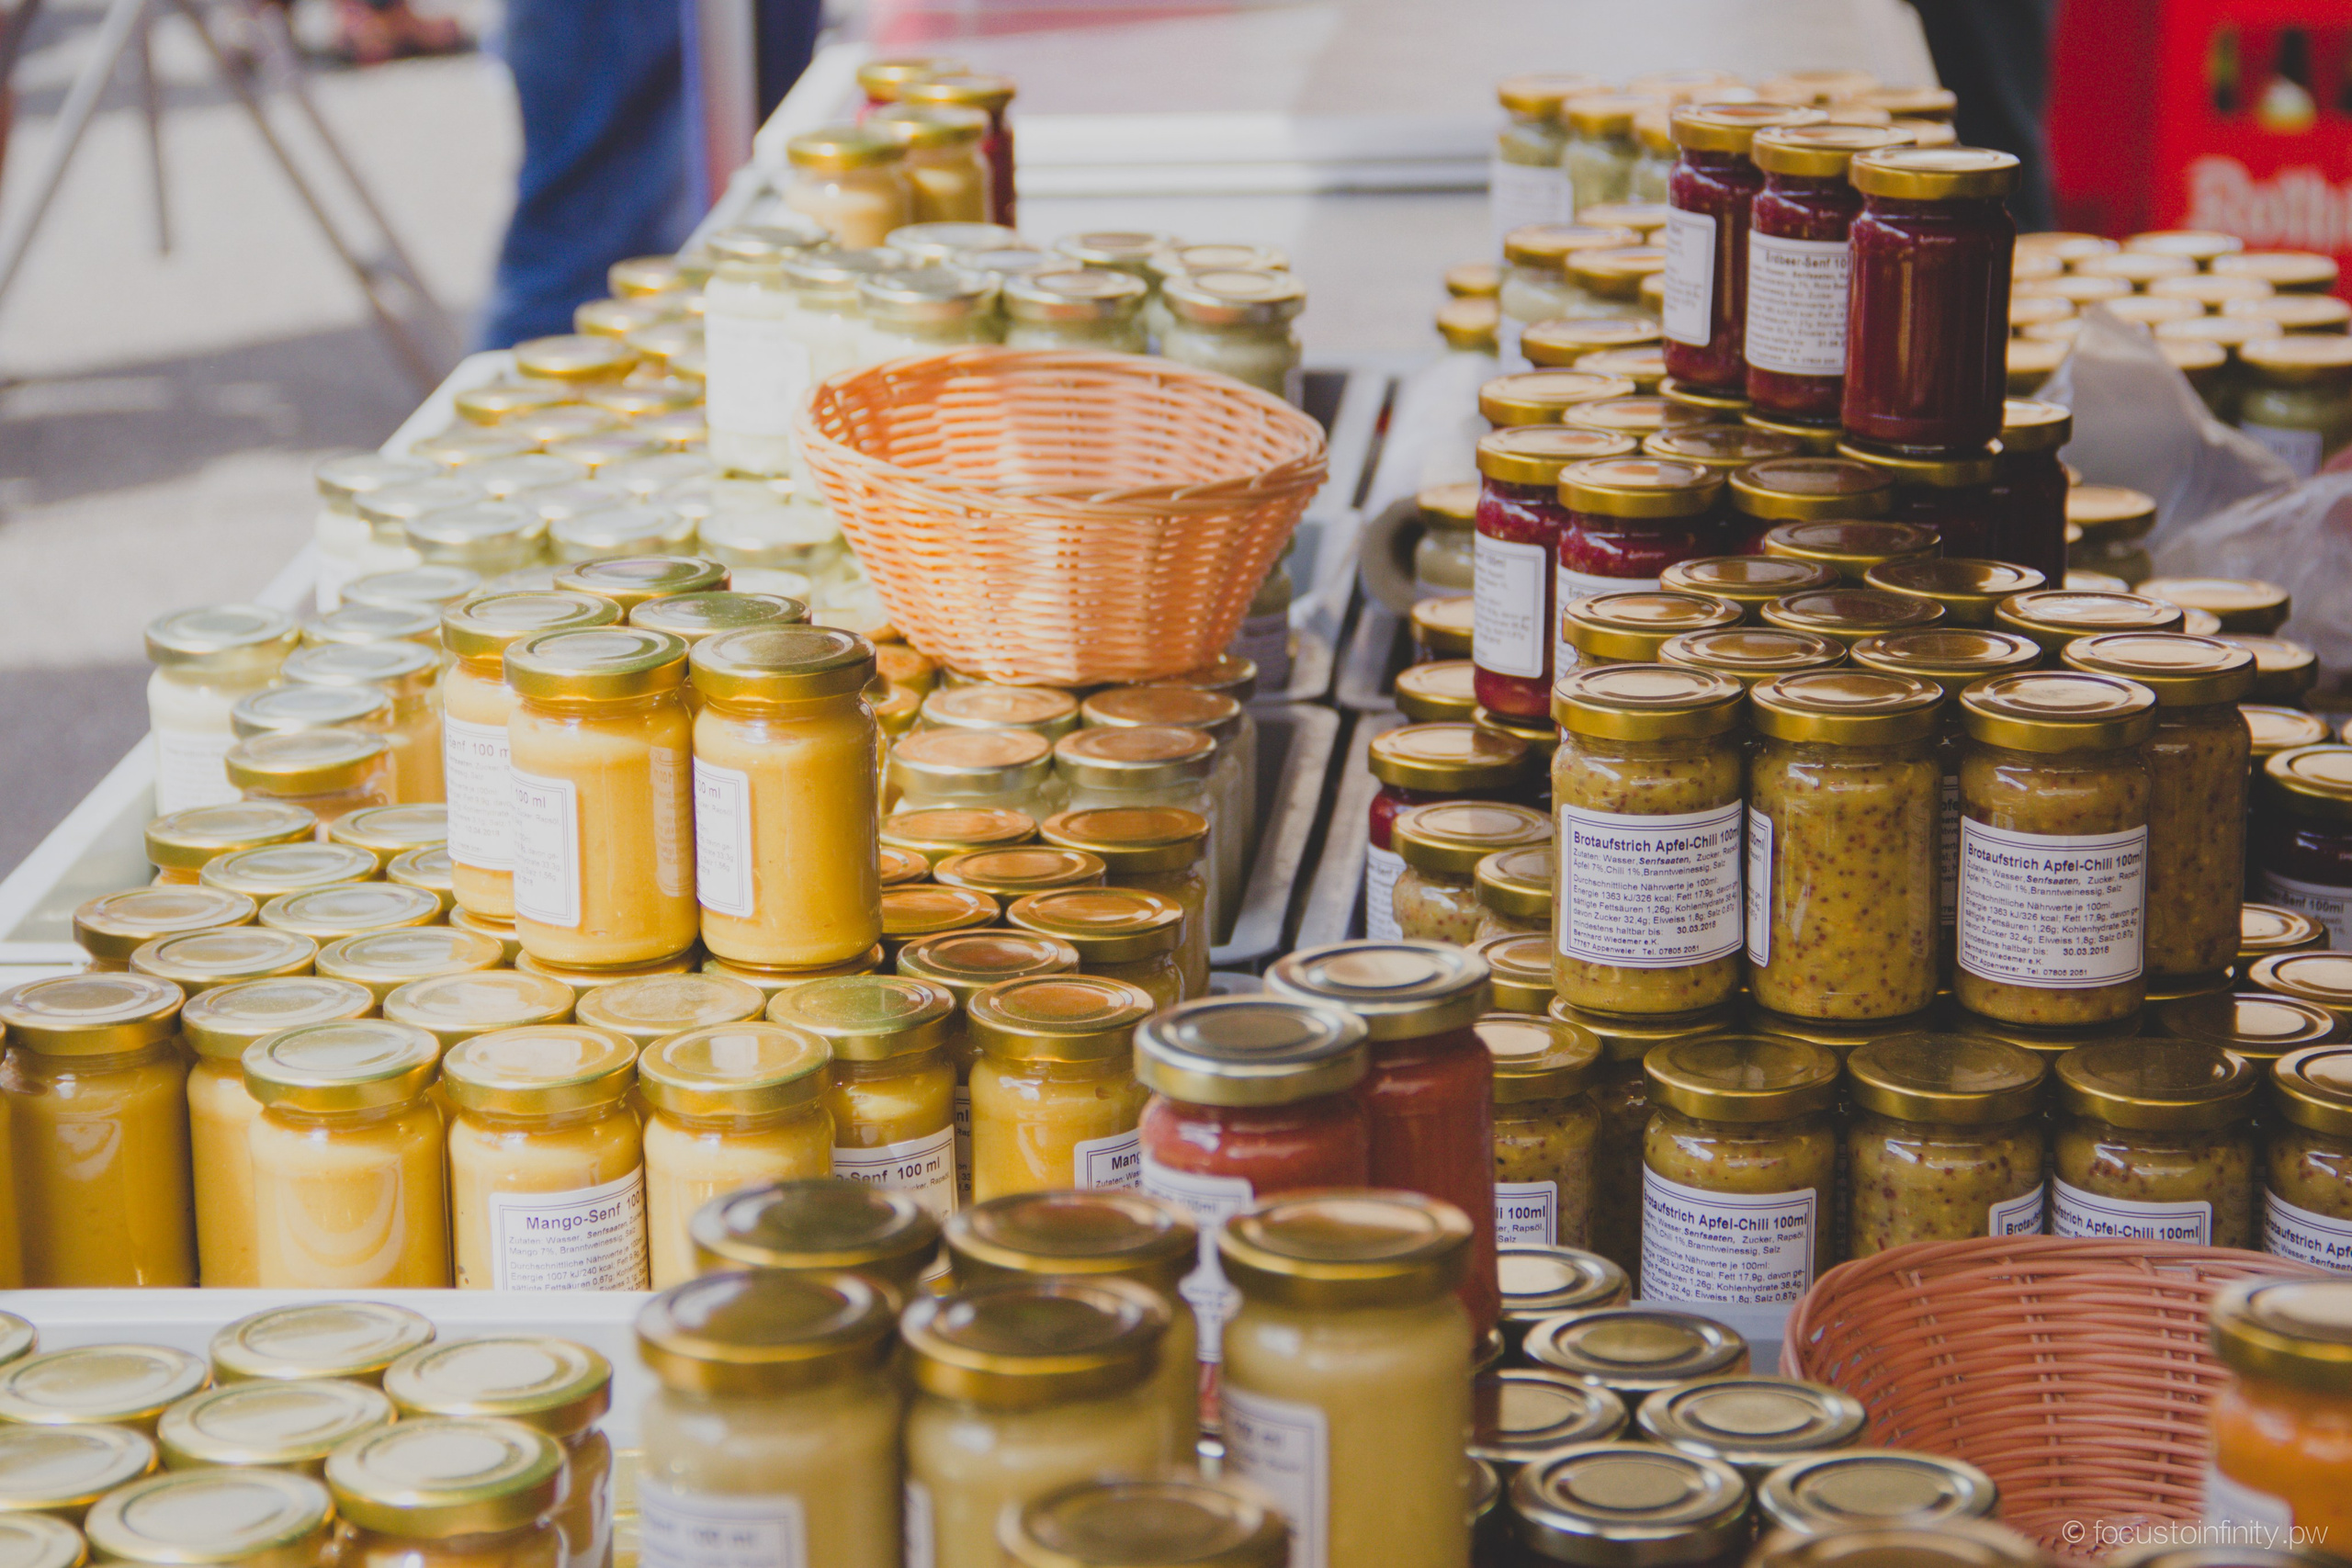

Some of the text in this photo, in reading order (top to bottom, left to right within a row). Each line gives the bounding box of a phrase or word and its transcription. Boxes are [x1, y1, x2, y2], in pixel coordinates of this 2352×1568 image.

[708, 786, 721, 799] ml
[533, 796, 546, 808] ml
[1574, 830, 1651, 852] Brotaufstrich
[1655, 832, 1718, 855] Apfel-Chili
[1968, 842, 2039, 871] Brotaufstrich
[2042, 857, 2113, 874] Apfel-Chili
[1573, 874, 1638, 891] Durchschnittliche
[1686, 882, 1694, 892] je
[2107, 885, 2122, 894] Salz
[1573, 885, 1599, 898] Energie
[1601, 891, 1622, 901] 1363
[1623, 894, 1652, 903] kJ/326
[1677, 893, 1692, 901] Fett
[1599, 901, 1644, 914] Fettsäuren
[1675, 897, 1724, 912] Kohlenhydrate
[2027, 901, 2073, 912] Nährwerte
[2075, 903, 2084, 913] je
[2310, 899, 2345, 914] 100ml
[1573, 908, 1592, 919] davon
[1594, 911, 1622, 923] Zucker
[1653, 916, 1686, 924] Eiweiss
[1707, 908, 1721, 919] Salz
[1989, 906, 2007, 917] 1363
[2009, 910, 2038, 921] kJ/326
[2064, 914, 2081, 922] Fett
[2109, 909, 2131, 919] davon
[1573, 919, 1614, 934] mindestens
[1616, 926, 1645, 936] haltbar
[1986, 916, 2030, 931] Fettsäuren
[2062, 922, 2120, 934] Kohlenhydrate
[1573, 928, 1602, 942] Bernhard
[1603, 935, 1642, 945] Wiedemer
[1982, 925, 2007, 939] Zucker
[2038, 935, 2073, 944] Eiweiss
[2098, 933, 2115, 943] Salz
[1592, 942, 1635, 955] Appenweier
[2002, 942, 2030, 954] haltbar
[2063, 945, 2110, 956] 30.03.2018
[1990, 951, 2027, 964] Wiedemer
[897, 1156, 941, 1180] 100 ml
[526, 1201, 621, 1231] Mango-Senf
[1508, 1205, 1545, 1220] 100ml
[1644, 1189, 1695, 1224] Brotaufstrich
[1699, 1214, 1769, 1231] Apfel-Chili
[1773, 1213, 1807, 1229] 100ml
[1512, 1224, 1545, 1234] Rapsöl,
[2086, 1218, 2154, 1239] Apfel-Chili
[2159, 1225, 2199, 1240] 100ml
[2265, 1213, 2322, 1253] Brotaufstrich
[1498, 1235, 1517, 1243] Salz
[1742, 1235, 1775, 1244] Zucker,
[509, 1247, 538, 1257] Mango
[510, 1259, 584, 1270] Durchschnittliche
[586, 1247, 623, 1265] Nährwerte
[1763, 1246, 1781, 1255] Salz
[1685, 1254, 1770, 1271] Nährwerte je 100ml:
[511, 1272, 544, 1282] Energie
[547, 1271, 567, 1280] 1007
[571, 1266, 597, 1278] kJ/240
[1718, 1271, 1736, 1281] Fett
[1767, 1271, 1792, 1280] davon
[1792, 1269, 1805, 1279] ge-
[1716, 1281, 1779, 1293] Kohlenhydrate
[1695, 1290, 1728, 1303] Eiweiss
[1755, 1294, 1773, 1303] Salz
